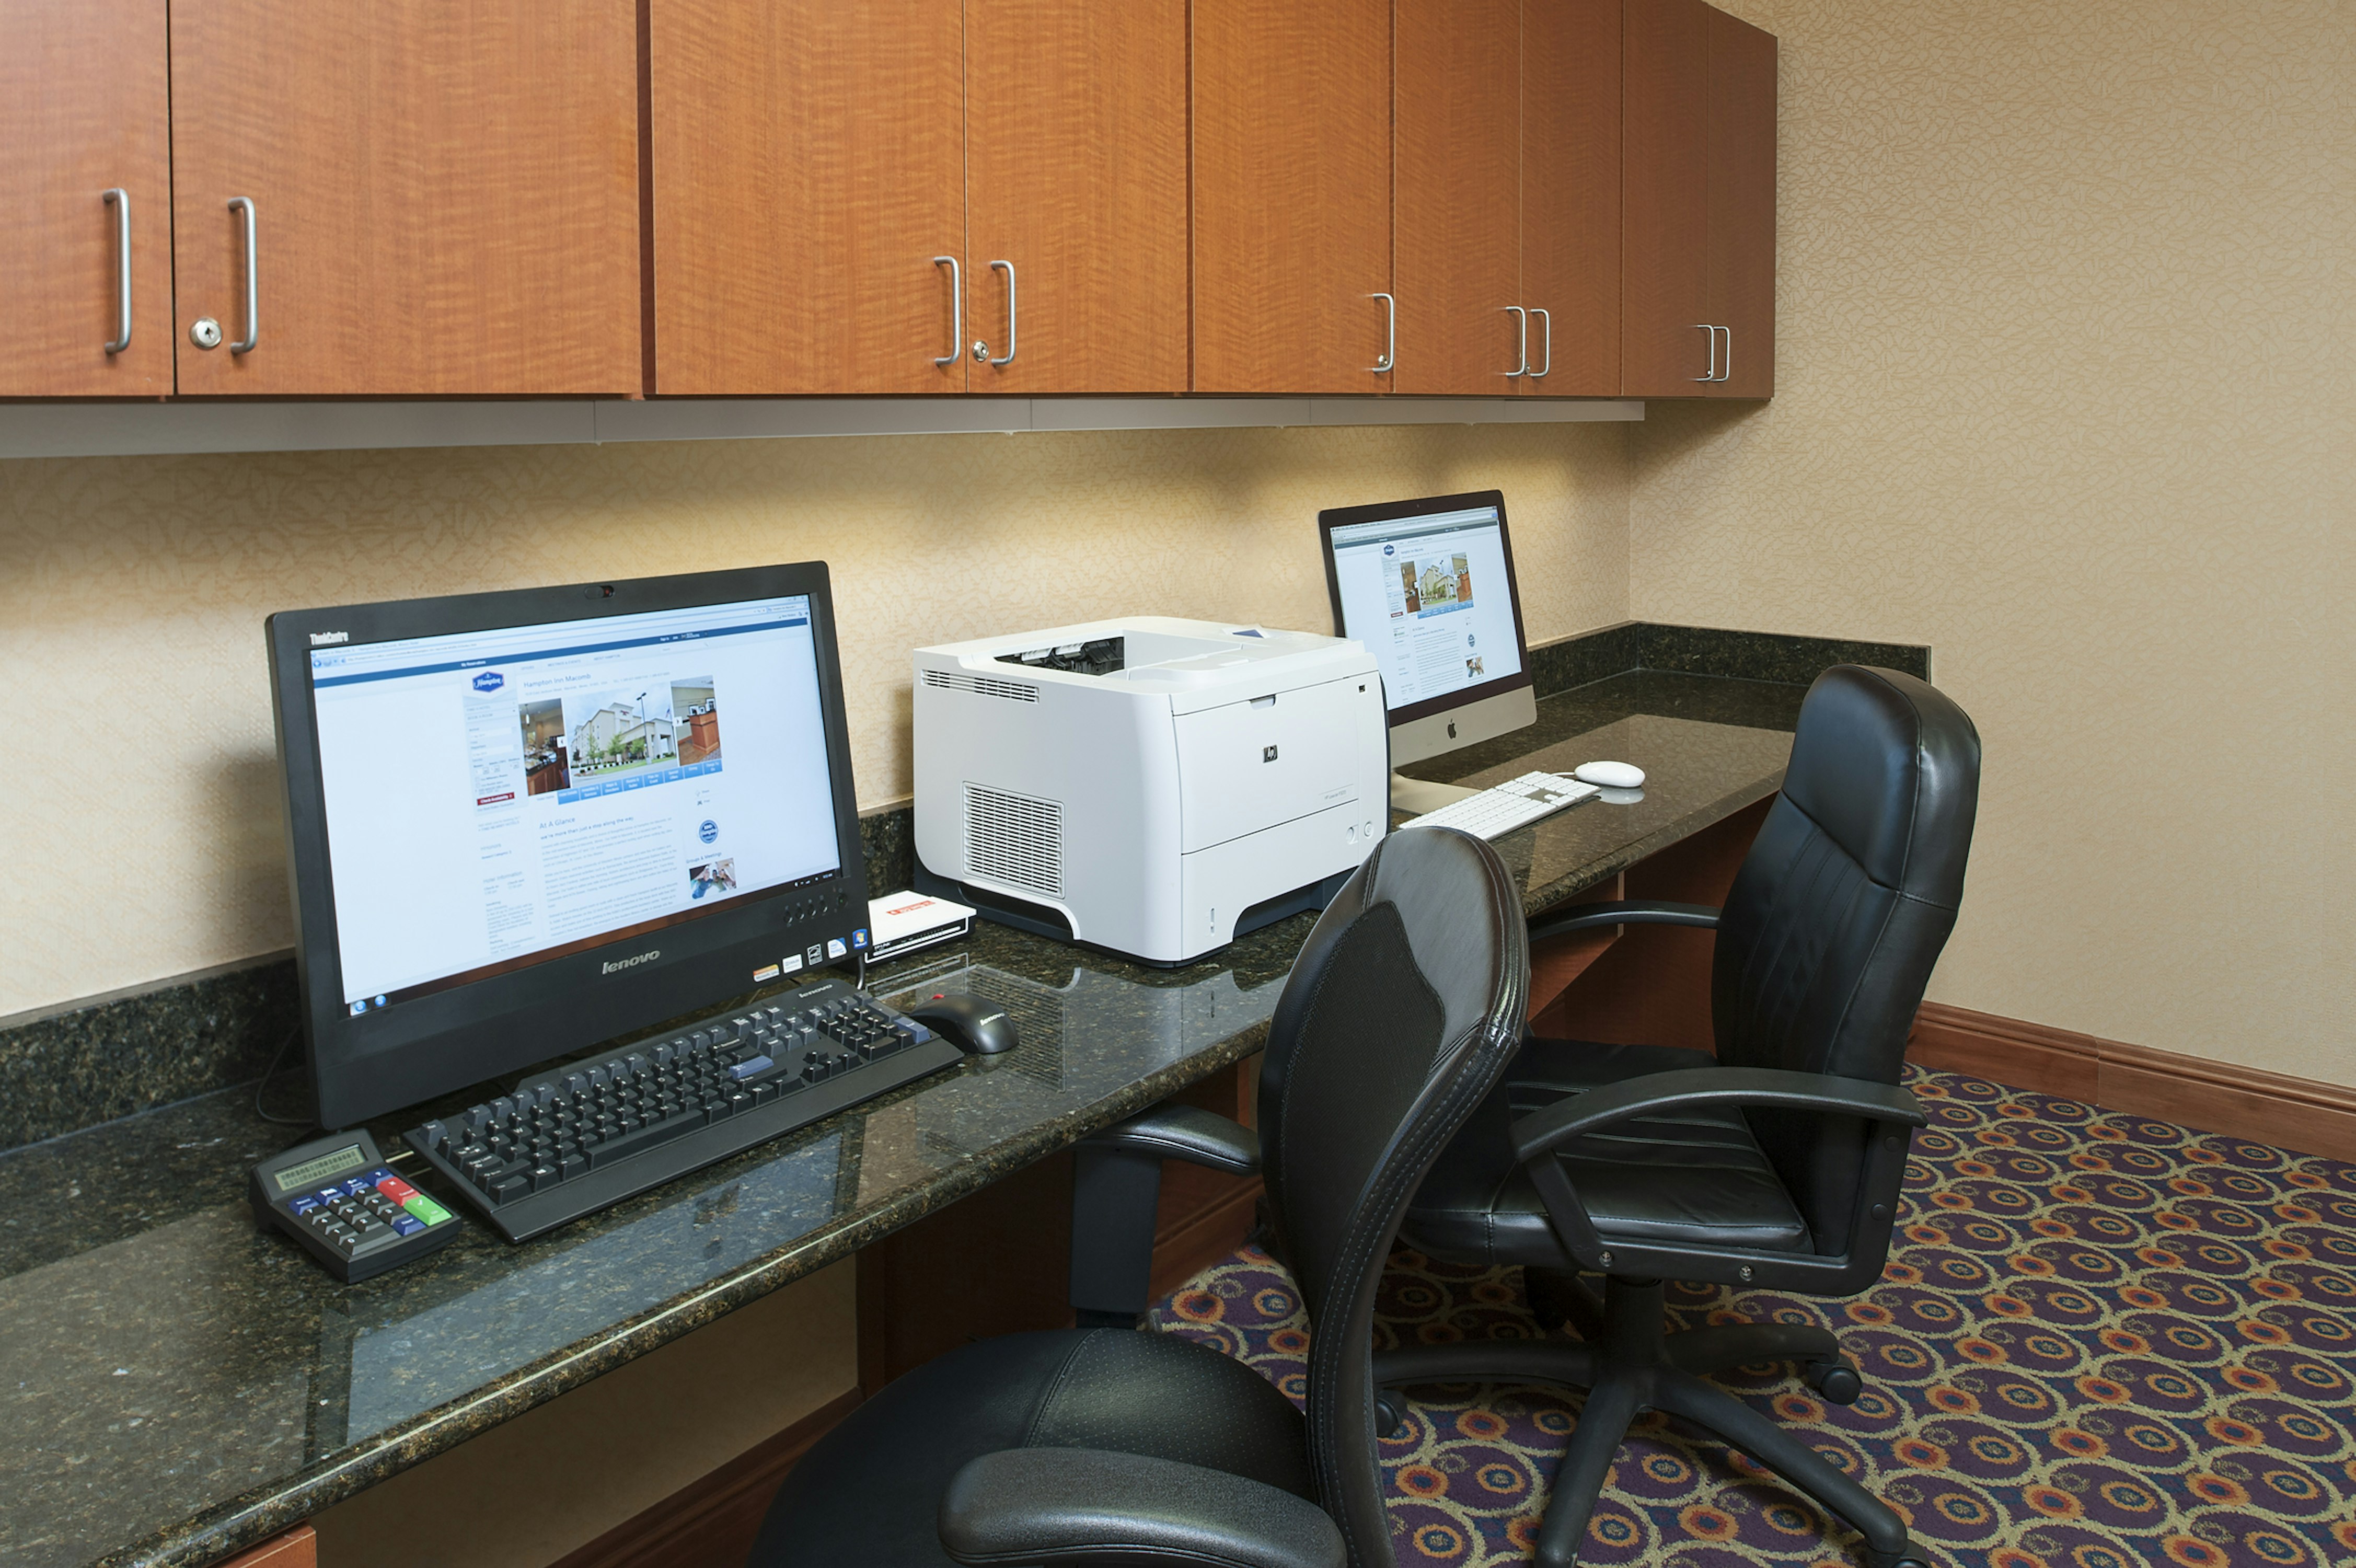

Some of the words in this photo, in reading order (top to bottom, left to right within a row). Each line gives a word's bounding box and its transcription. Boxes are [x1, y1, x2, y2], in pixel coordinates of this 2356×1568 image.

[309, 631, 349, 645] ThinkCentre
[473, 675, 503, 688] Hampton
[523, 678, 553, 689] Hampton
[564, 673, 591, 682] Macomb
[554, 815, 575, 826] Glance
[603, 819, 616, 827] along
[704, 850, 722, 860] Meetings
[602, 950, 660, 975] lenovo
[799, 984, 833, 998] lenovo
[980, 1012, 1005, 1026] lenovo
